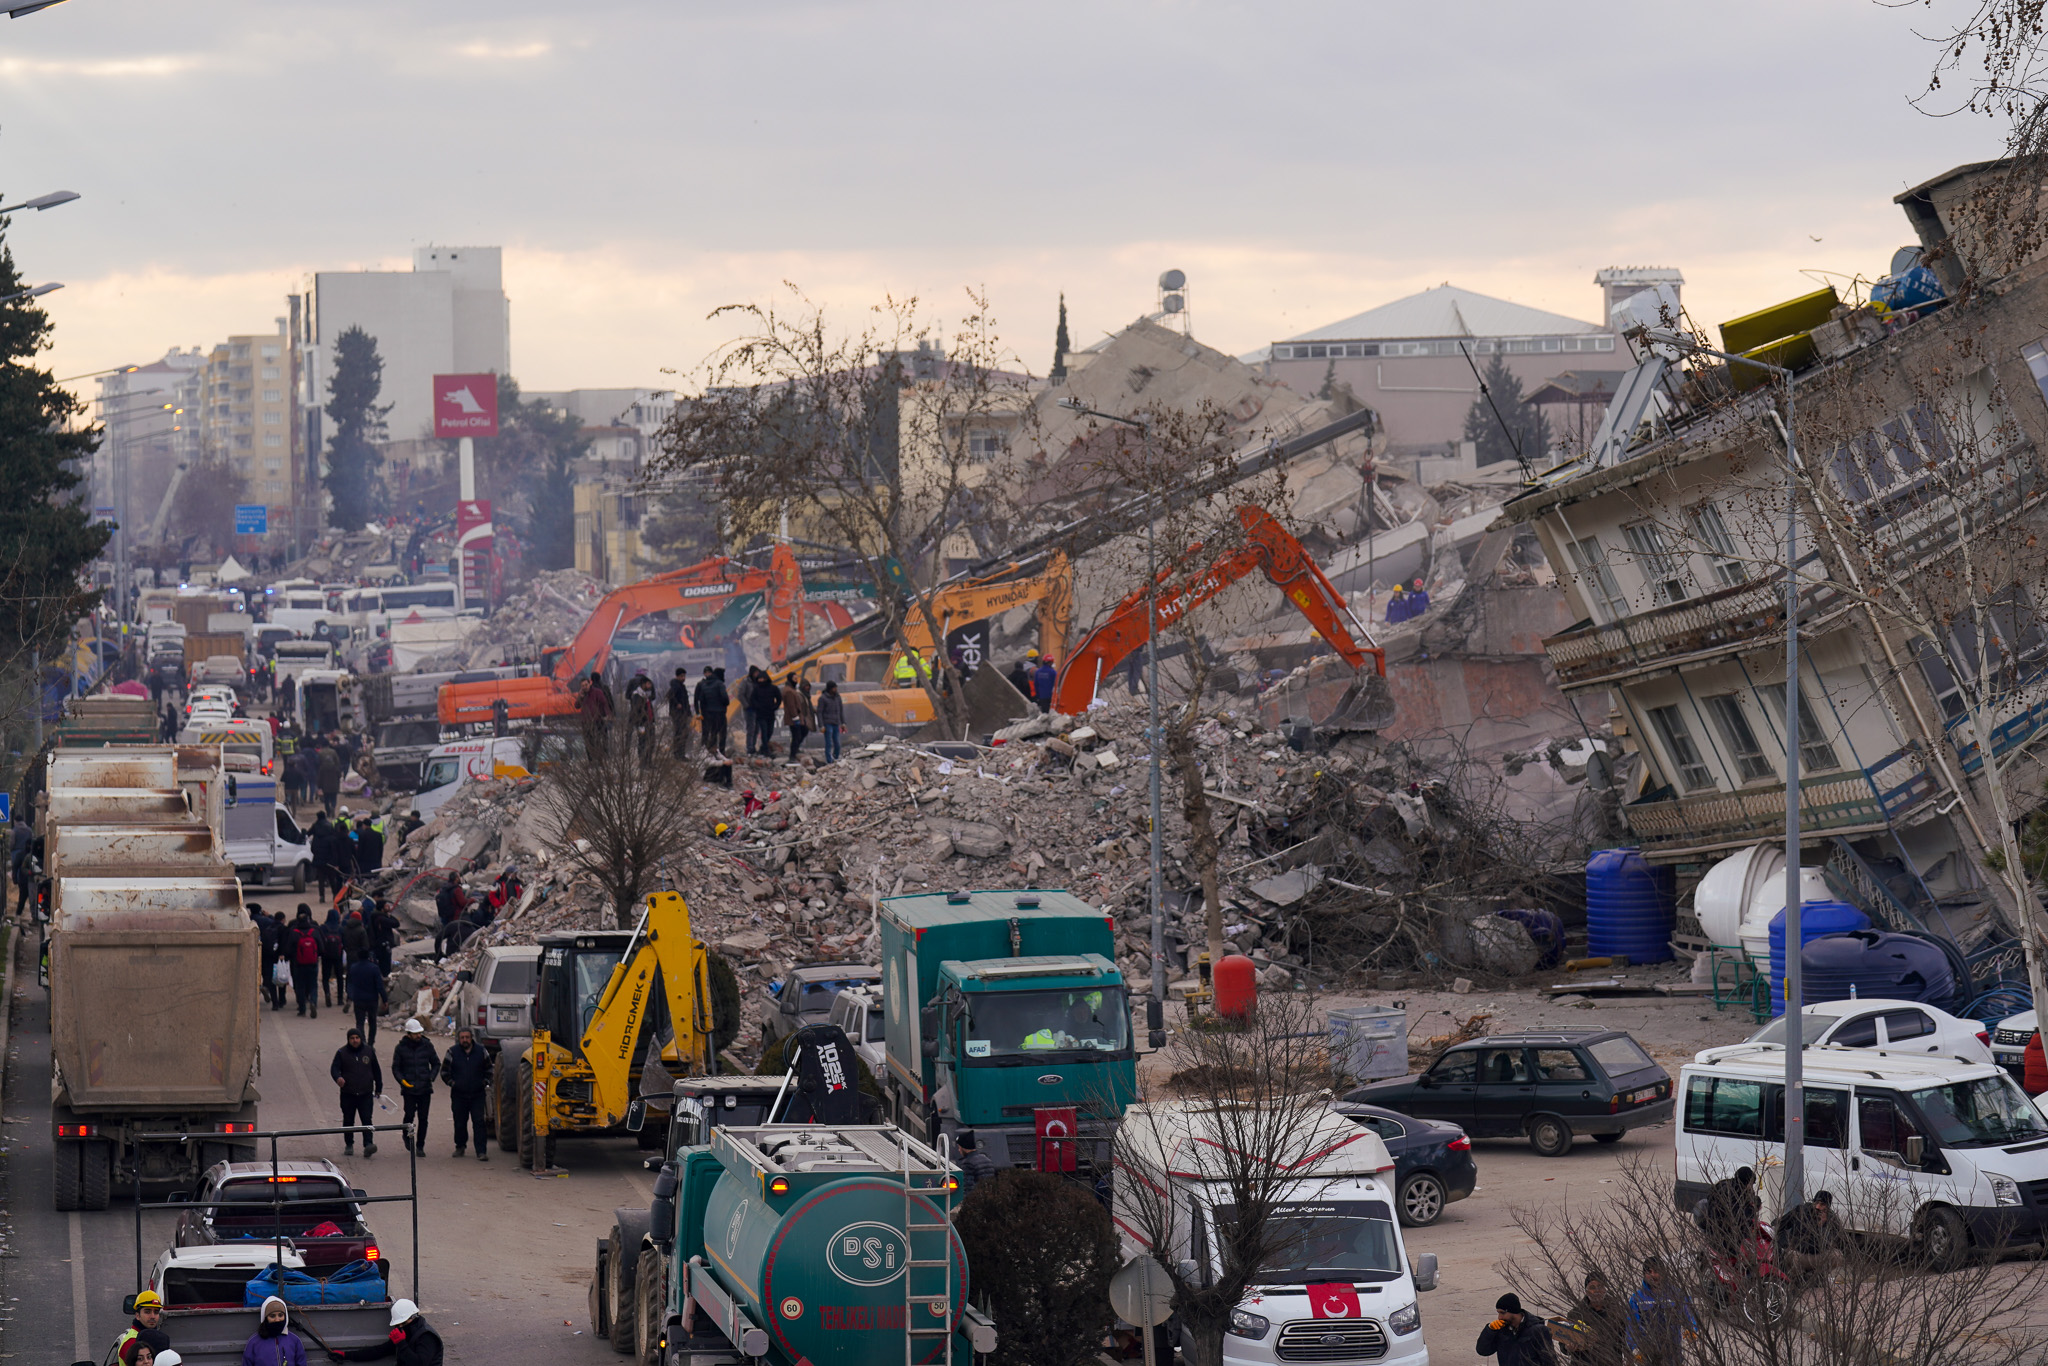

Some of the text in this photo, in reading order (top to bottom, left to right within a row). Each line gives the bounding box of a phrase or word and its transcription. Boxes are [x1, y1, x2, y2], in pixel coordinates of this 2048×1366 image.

[441, 417, 491, 428] Petrol Ofisi
[684, 583, 734, 598] DOOSAN
[968, 1046, 987, 1054] AFAD
[816, 1045, 834, 1095] ALPHA
[786, 1304, 798, 1313] 60
[933, 1302, 945, 1310] 50
[877, 1305, 913, 1330] MADD
